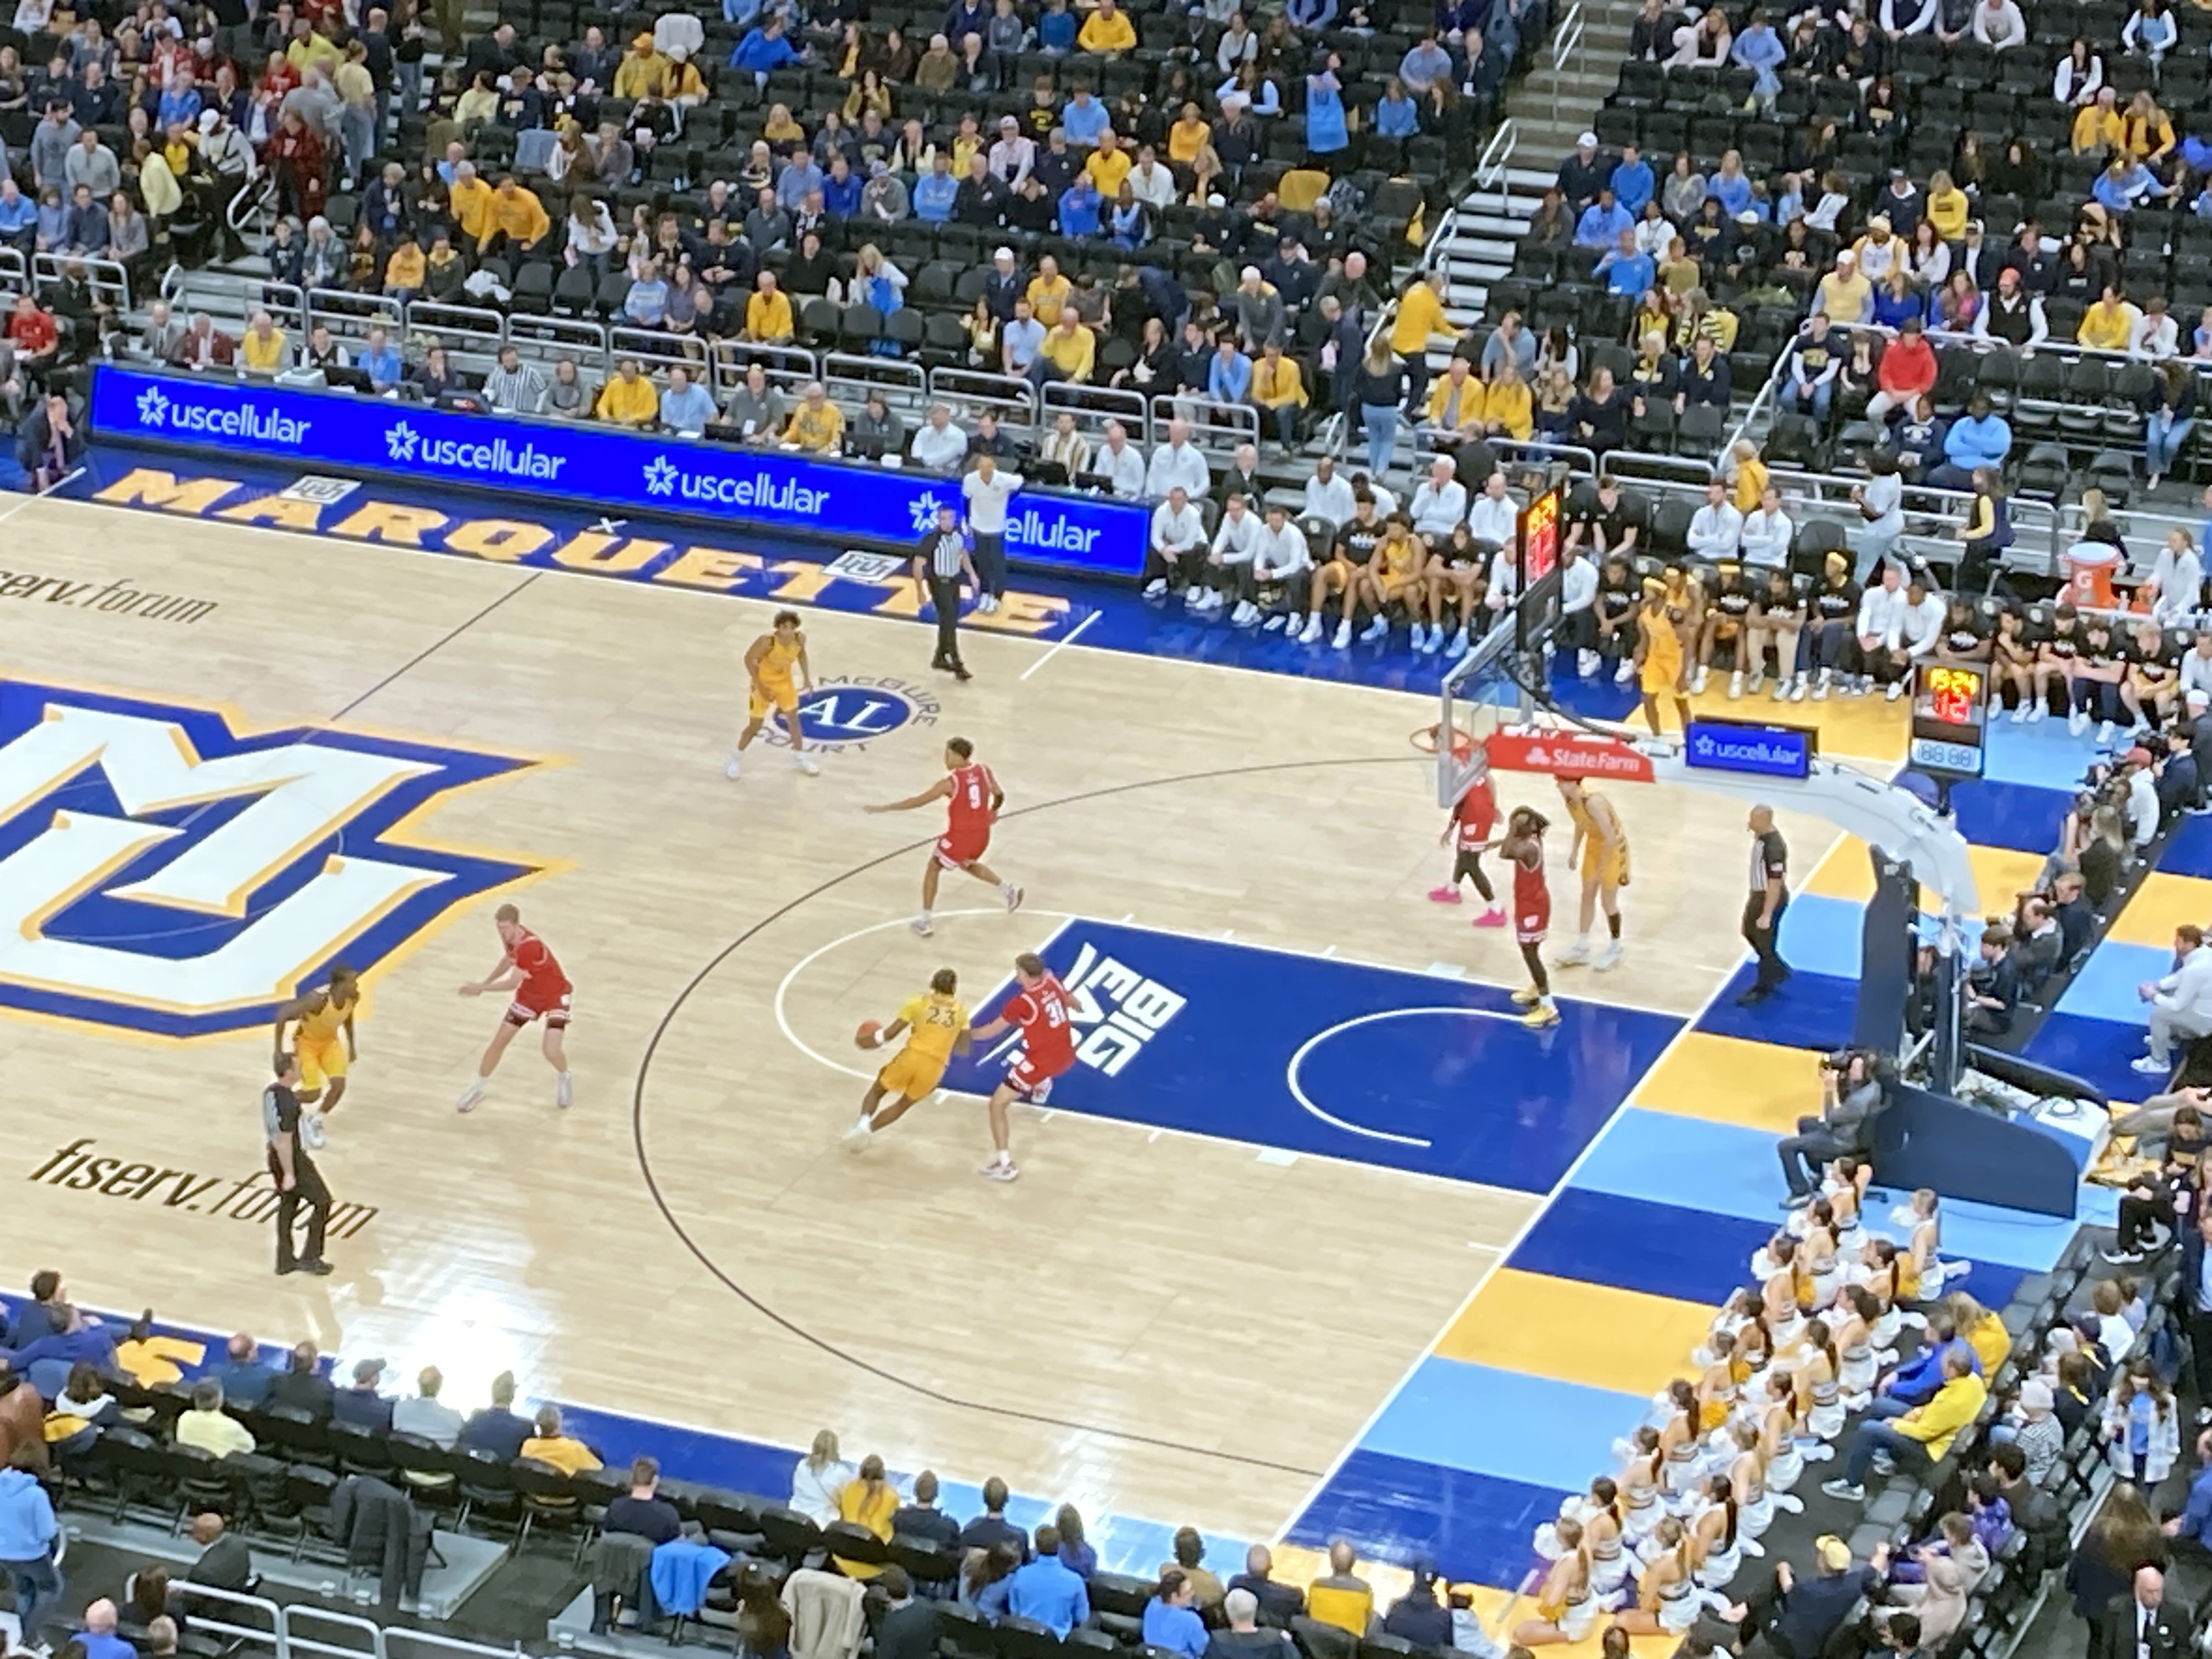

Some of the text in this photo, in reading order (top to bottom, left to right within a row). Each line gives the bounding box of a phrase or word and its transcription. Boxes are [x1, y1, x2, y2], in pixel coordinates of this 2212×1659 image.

[172, 404, 312, 444] uscellular
[421, 438, 567, 479] uscellular
[681, 473, 830, 514] uscellular
[1005, 510, 1101, 552] ellular
[2076, 570, 2094, 589] G
[777, 695, 893, 733] AL
[926, 1006, 956, 1029] 23
